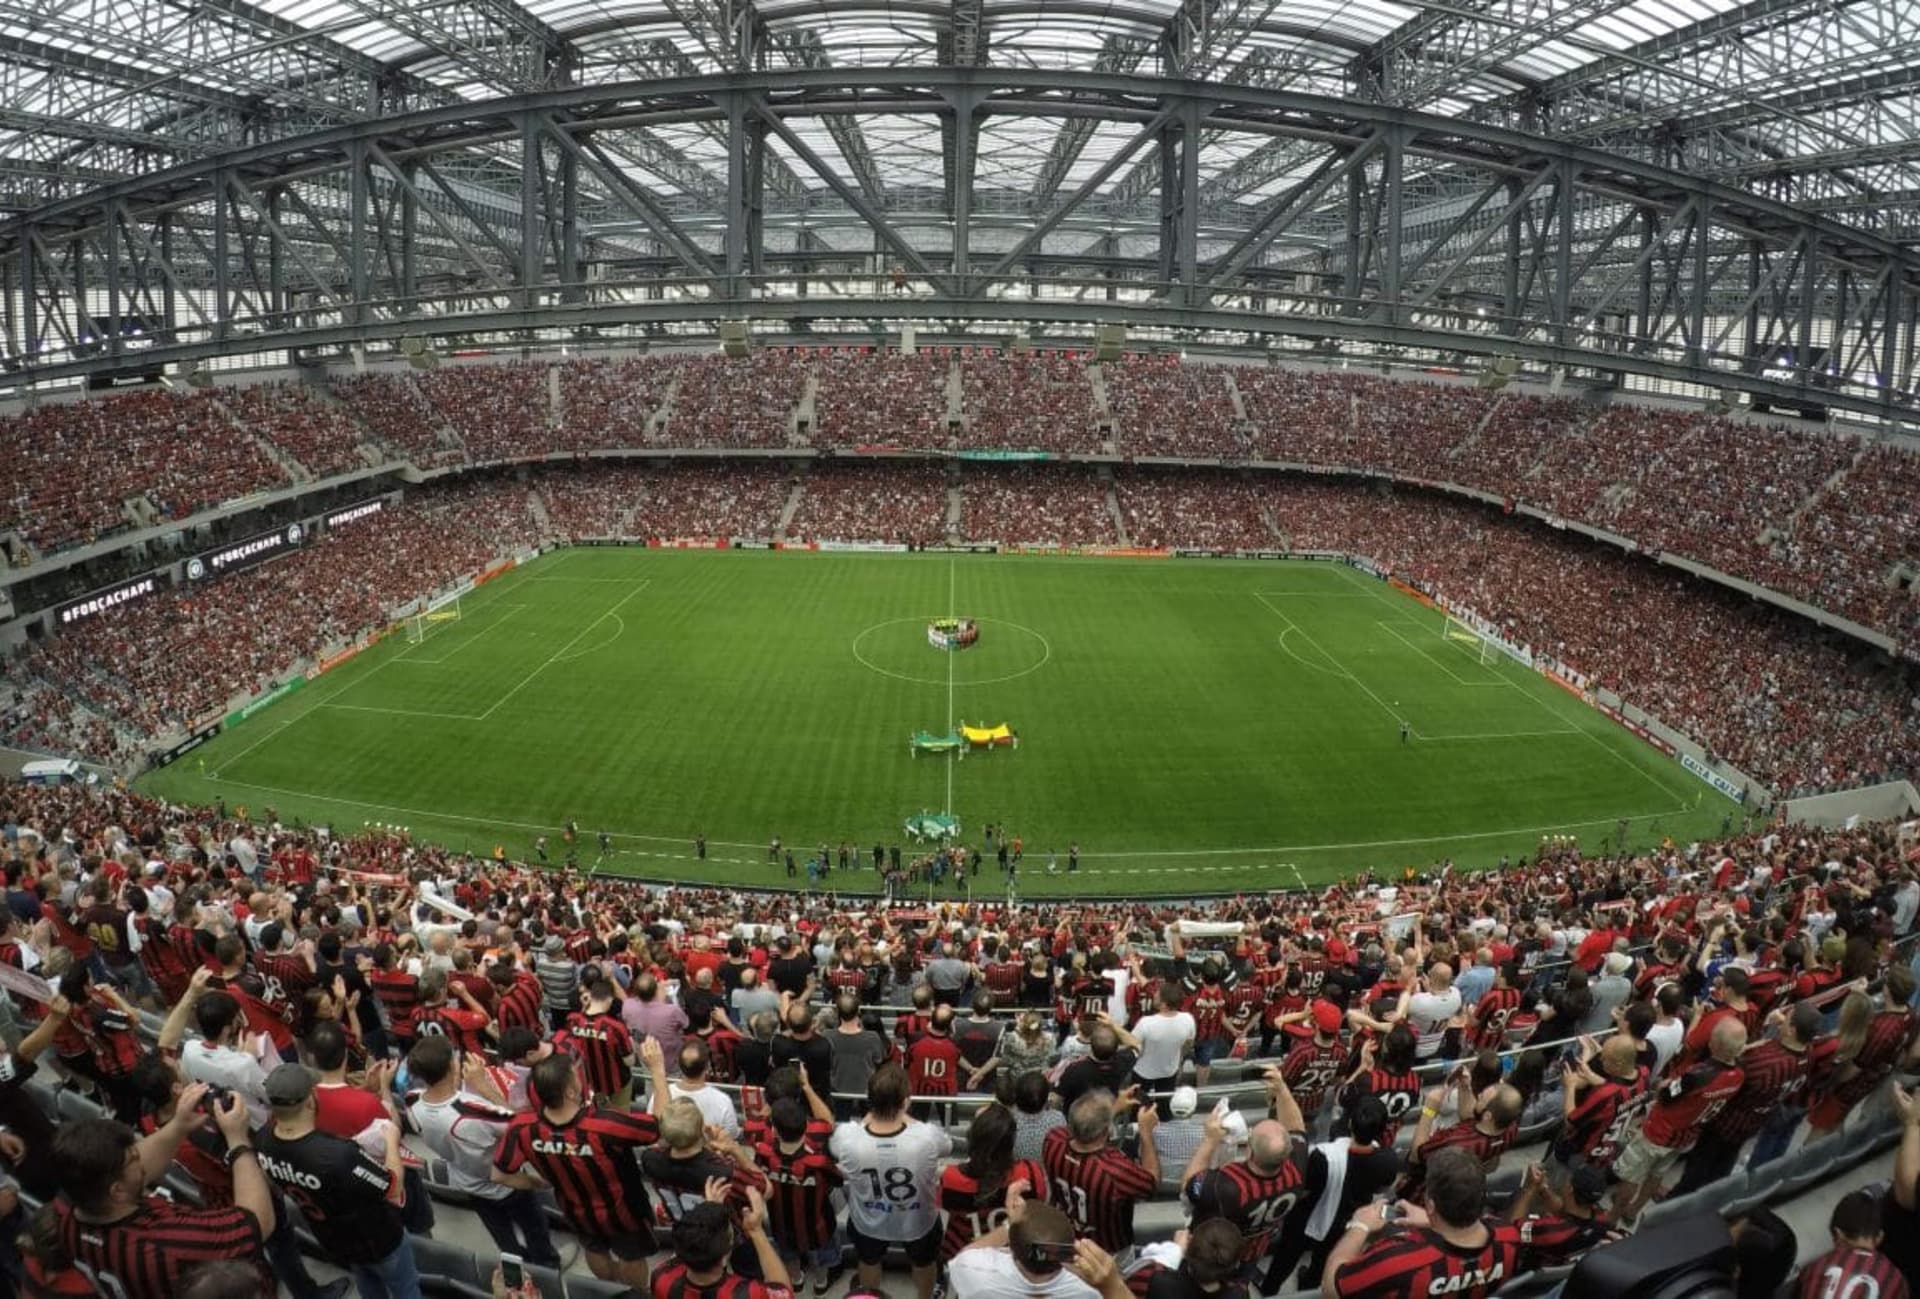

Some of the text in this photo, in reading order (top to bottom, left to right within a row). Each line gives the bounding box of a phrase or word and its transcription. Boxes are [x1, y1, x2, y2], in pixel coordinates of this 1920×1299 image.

[1684, 758, 1743, 799] CAIXA CAIXA
[417, 1021, 443, 1037] 10
[572, 1026, 607, 1041] CAIXA
[924, 1058, 946, 1077] 10
[1379, 1091, 1411, 1118] 10
[532, 1139, 593, 1156] CAIXA
[862, 1167, 917, 1201] 18
[1247, 1191, 1297, 1227] 10
[1429, 1262, 1503, 1295] CAIXA
[1824, 1266, 1880, 1299] 10
